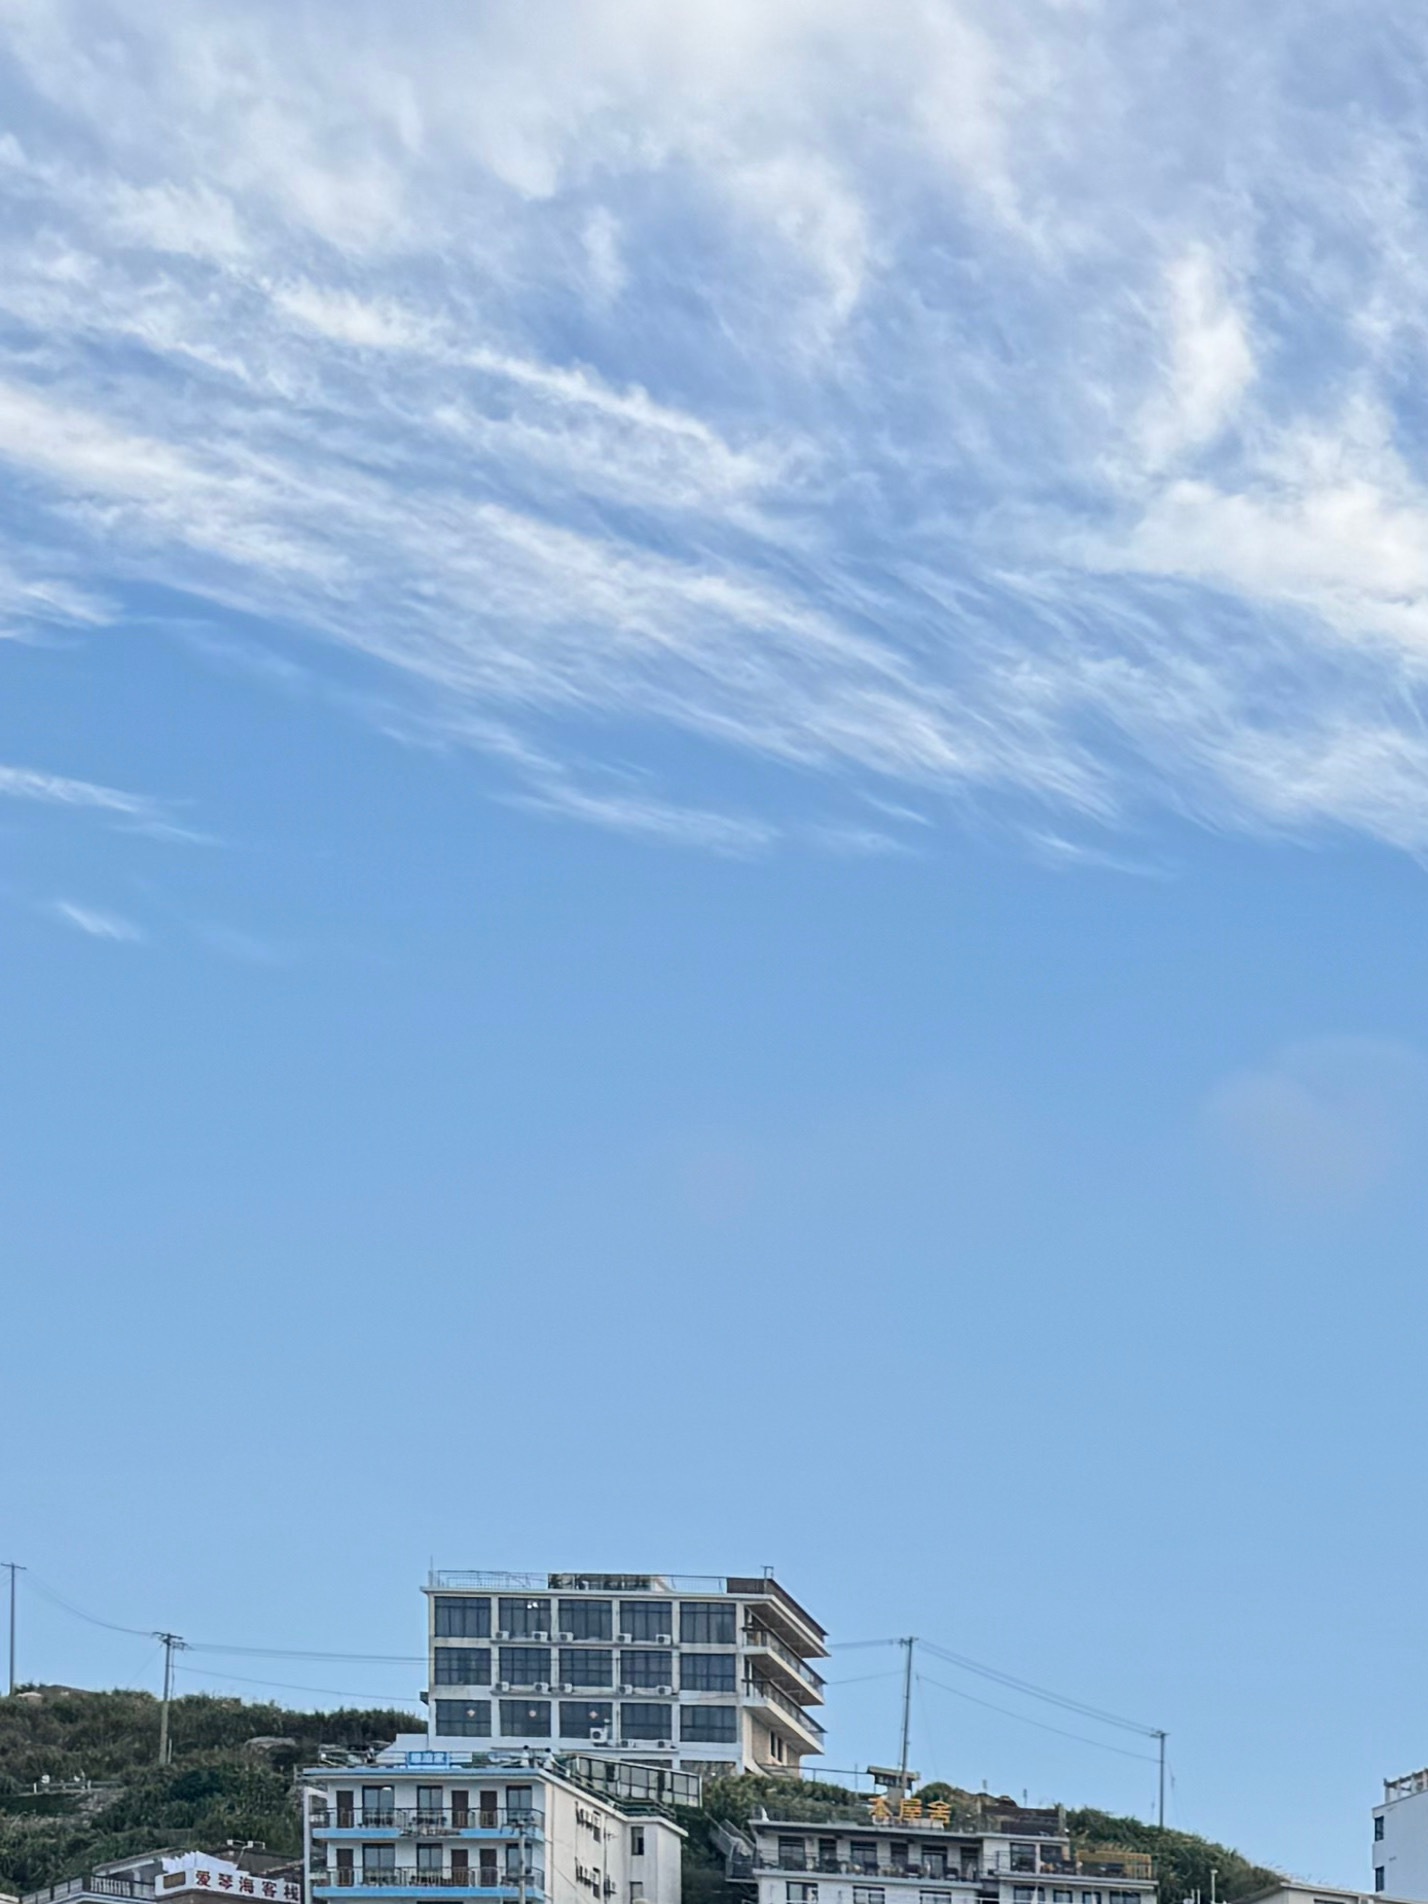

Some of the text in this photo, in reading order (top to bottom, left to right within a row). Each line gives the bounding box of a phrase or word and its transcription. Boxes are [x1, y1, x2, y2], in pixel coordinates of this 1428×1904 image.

[195, 1870, 300, 1901] 爱琴海客栈
